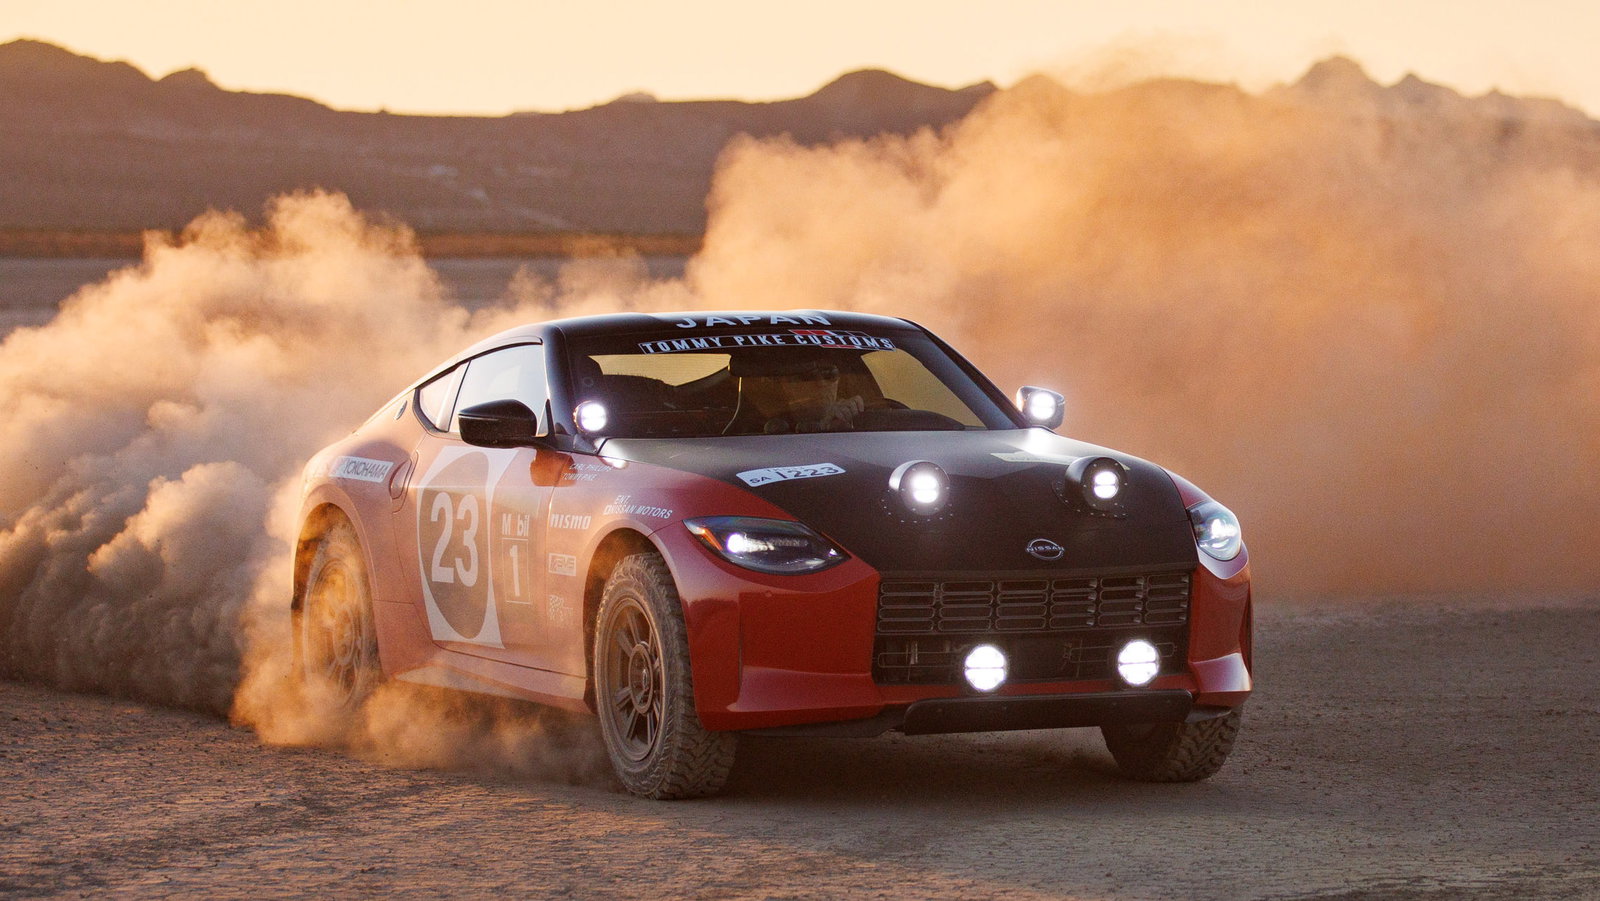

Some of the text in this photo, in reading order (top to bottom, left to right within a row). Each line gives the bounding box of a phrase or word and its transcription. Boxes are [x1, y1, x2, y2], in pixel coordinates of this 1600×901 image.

[676, 315, 831, 328] JAPAN
[642, 335, 893, 353] TOMMY PIKE CUSTOMS
[775, 466, 839, 479] 1223
[637, 506, 673, 519] MOTORS
[431, 491, 479, 587] 23
[509, 544, 520, 597] 1
